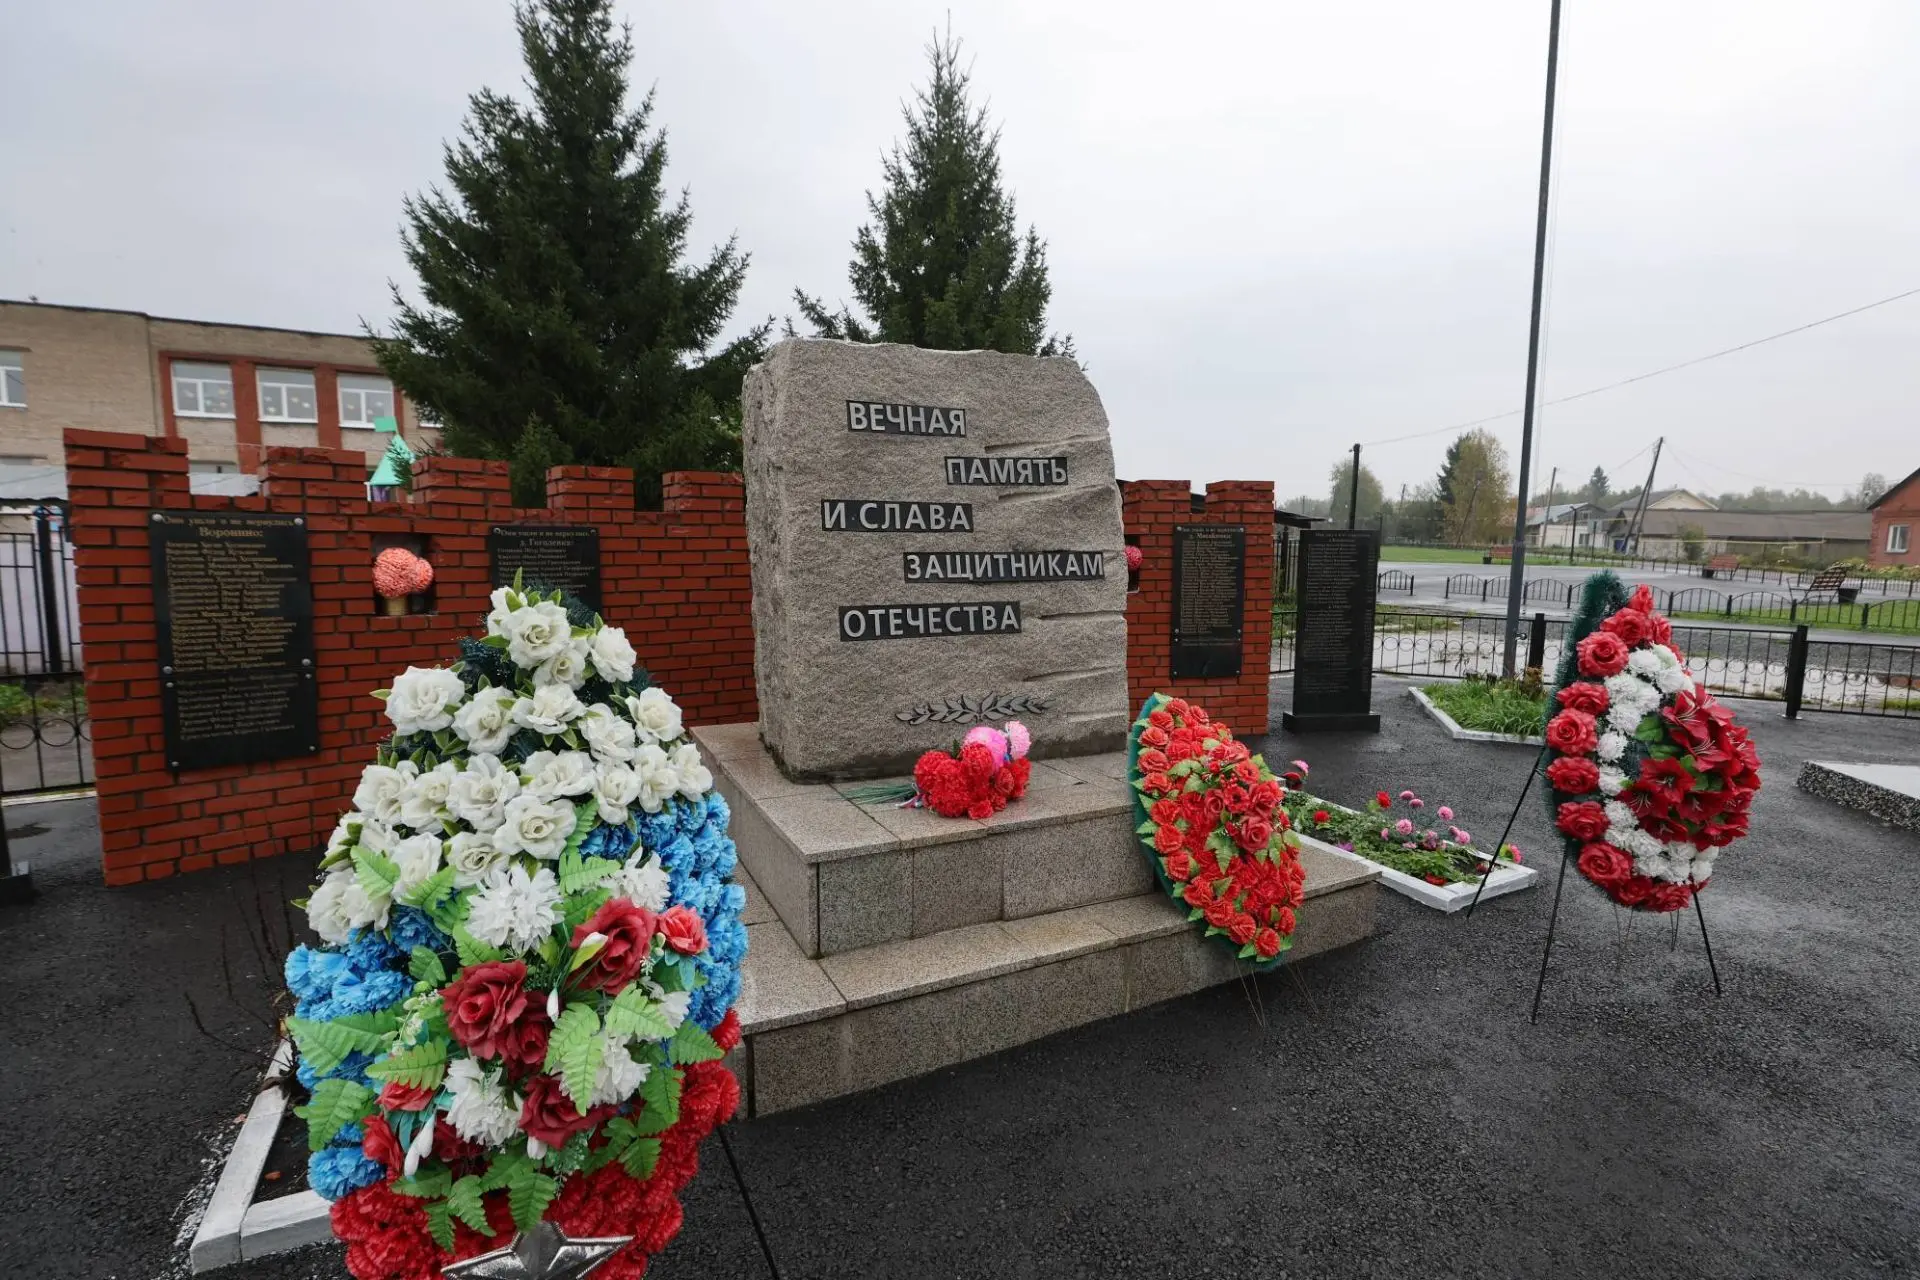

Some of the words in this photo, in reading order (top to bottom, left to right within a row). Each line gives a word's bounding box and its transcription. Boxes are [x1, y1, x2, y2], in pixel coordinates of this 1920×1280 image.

[849, 402, 966, 435] ВЕЧНАЯ
[946, 457, 1067, 485] ПАМЯТЬ
[823, 501, 846, 529] И
[859, 502, 971, 531] СЛАВА
[906, 552, 1104, 581] ЗАЩИТНИКАМ
[843, 604, 1020, 638] ОТЕЧЕСТВА
